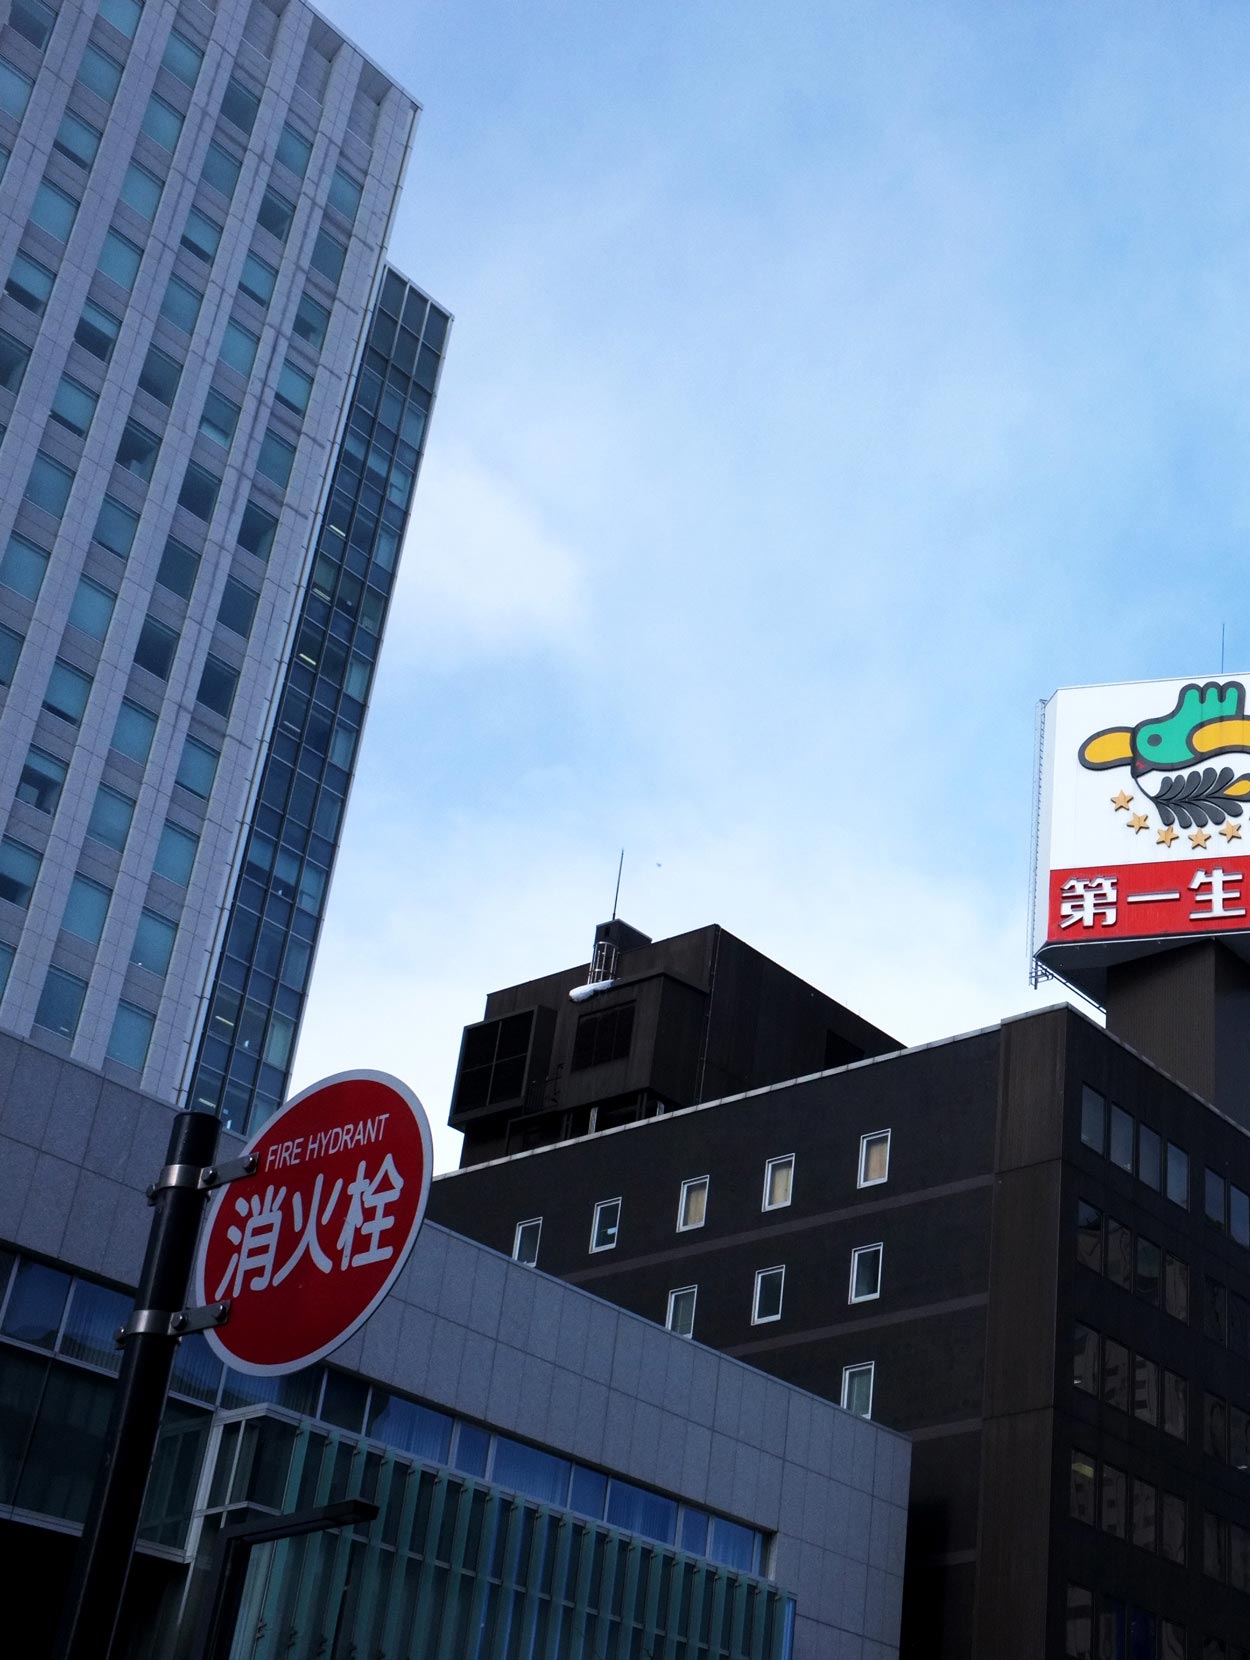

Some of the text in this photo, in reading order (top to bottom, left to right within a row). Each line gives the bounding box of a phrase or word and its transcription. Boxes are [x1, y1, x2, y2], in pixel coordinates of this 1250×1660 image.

[265, 1113, 390, 1173] FIRE HYDRANT
[214, 1152, 405, 1301] 消火栓
